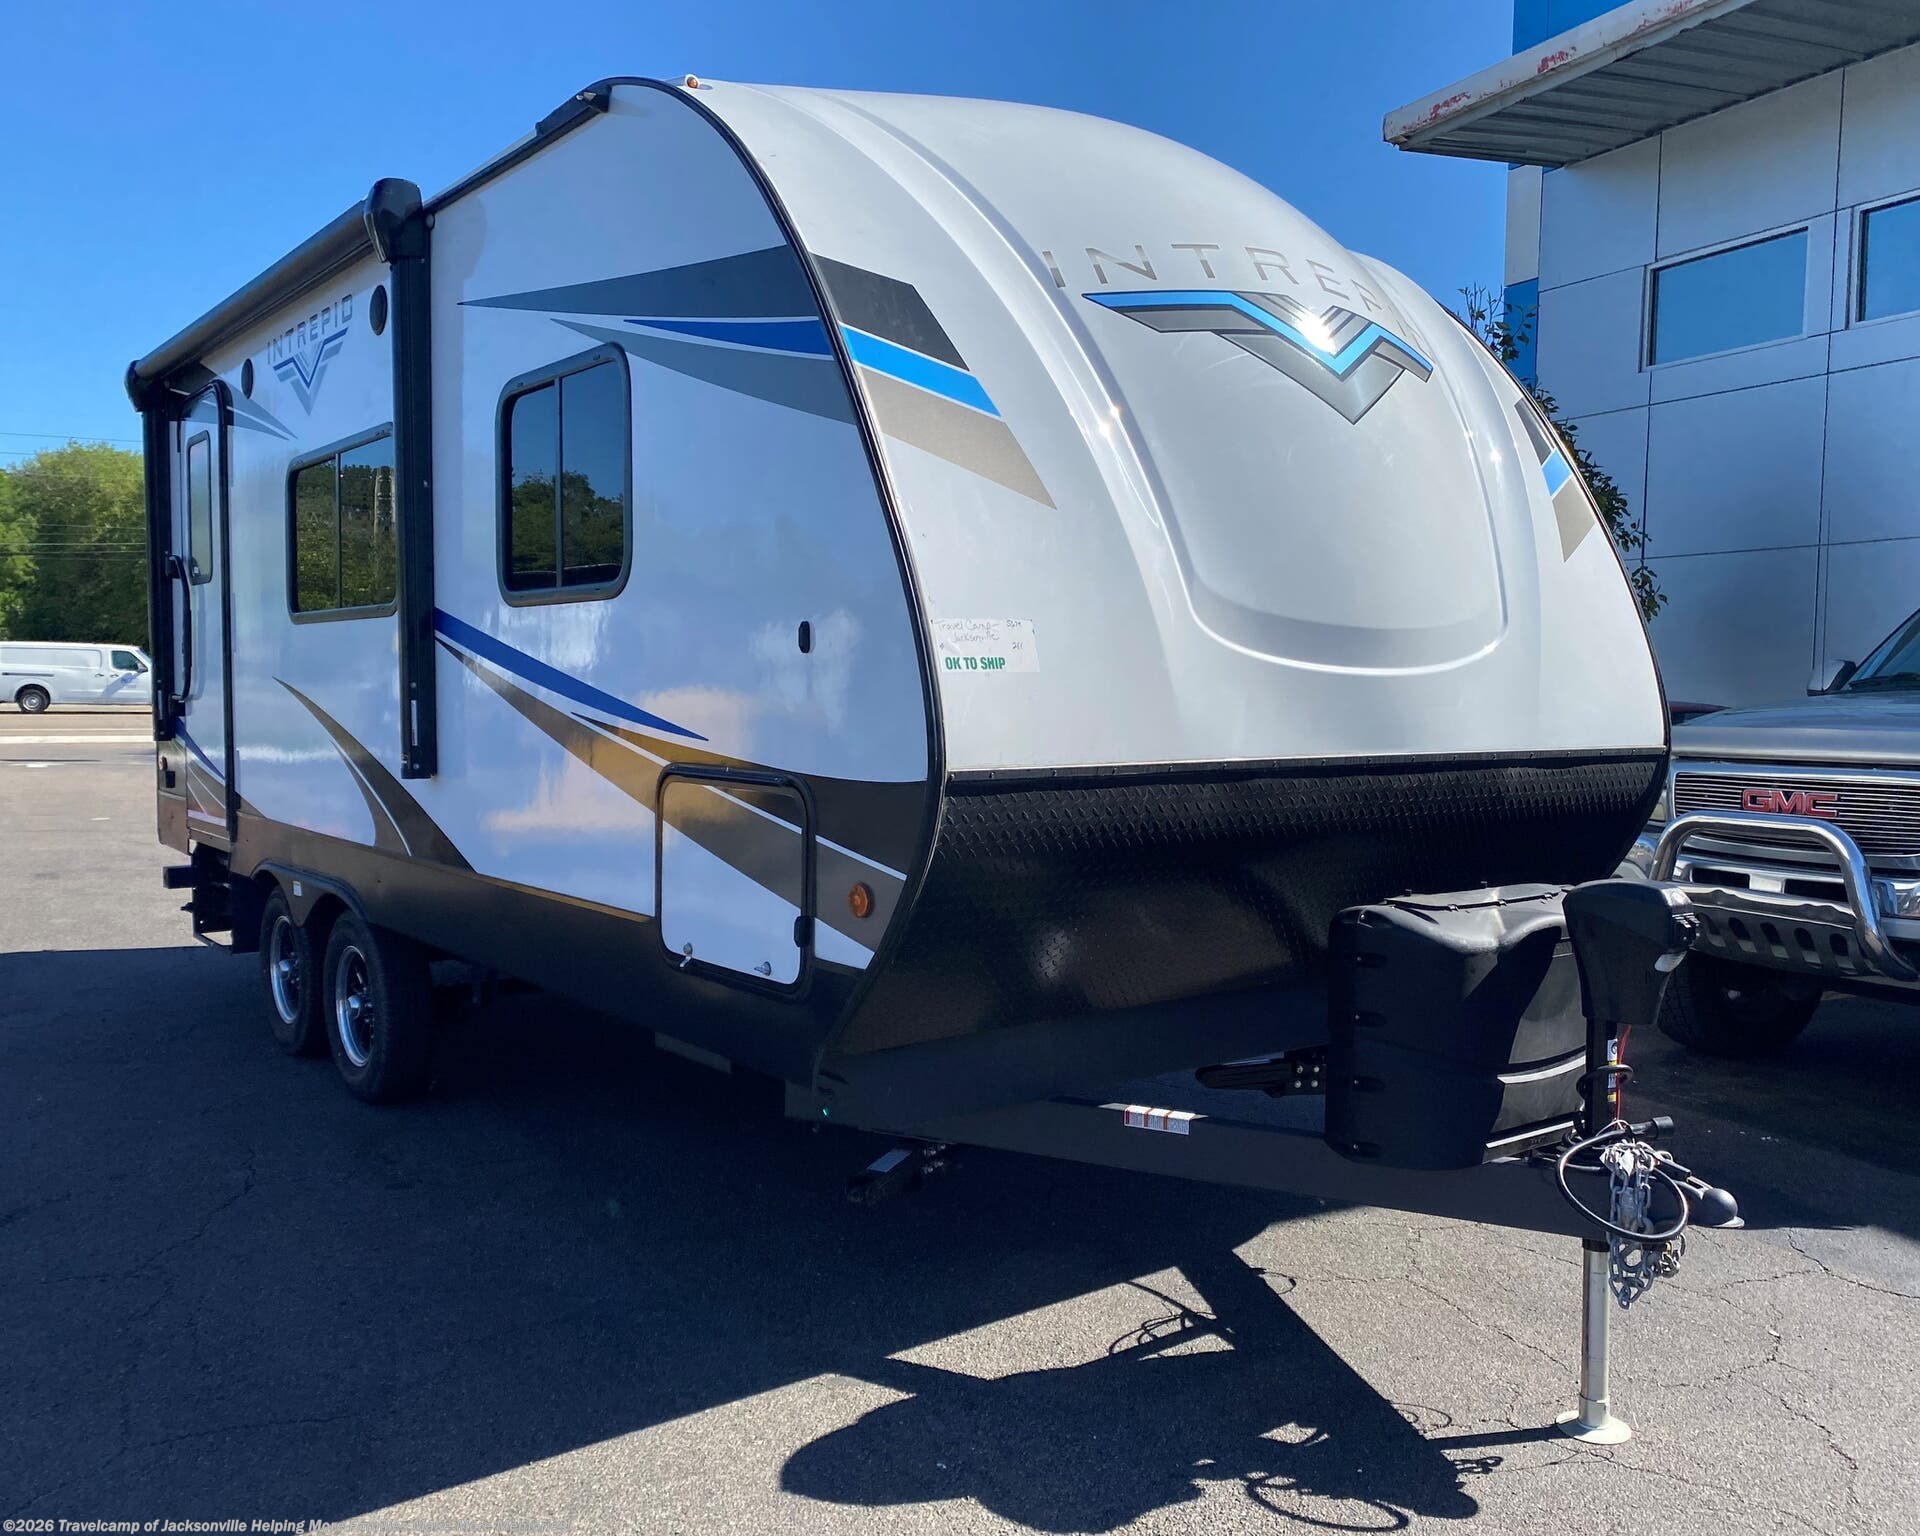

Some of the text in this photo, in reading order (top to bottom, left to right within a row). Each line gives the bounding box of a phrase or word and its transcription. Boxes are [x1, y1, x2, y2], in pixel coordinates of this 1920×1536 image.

[266, 293, 353, 365] INTREPID
[945, 656, 1006, 670] OK TO SHIP
[1742, 788, 1838, 817] GMC
